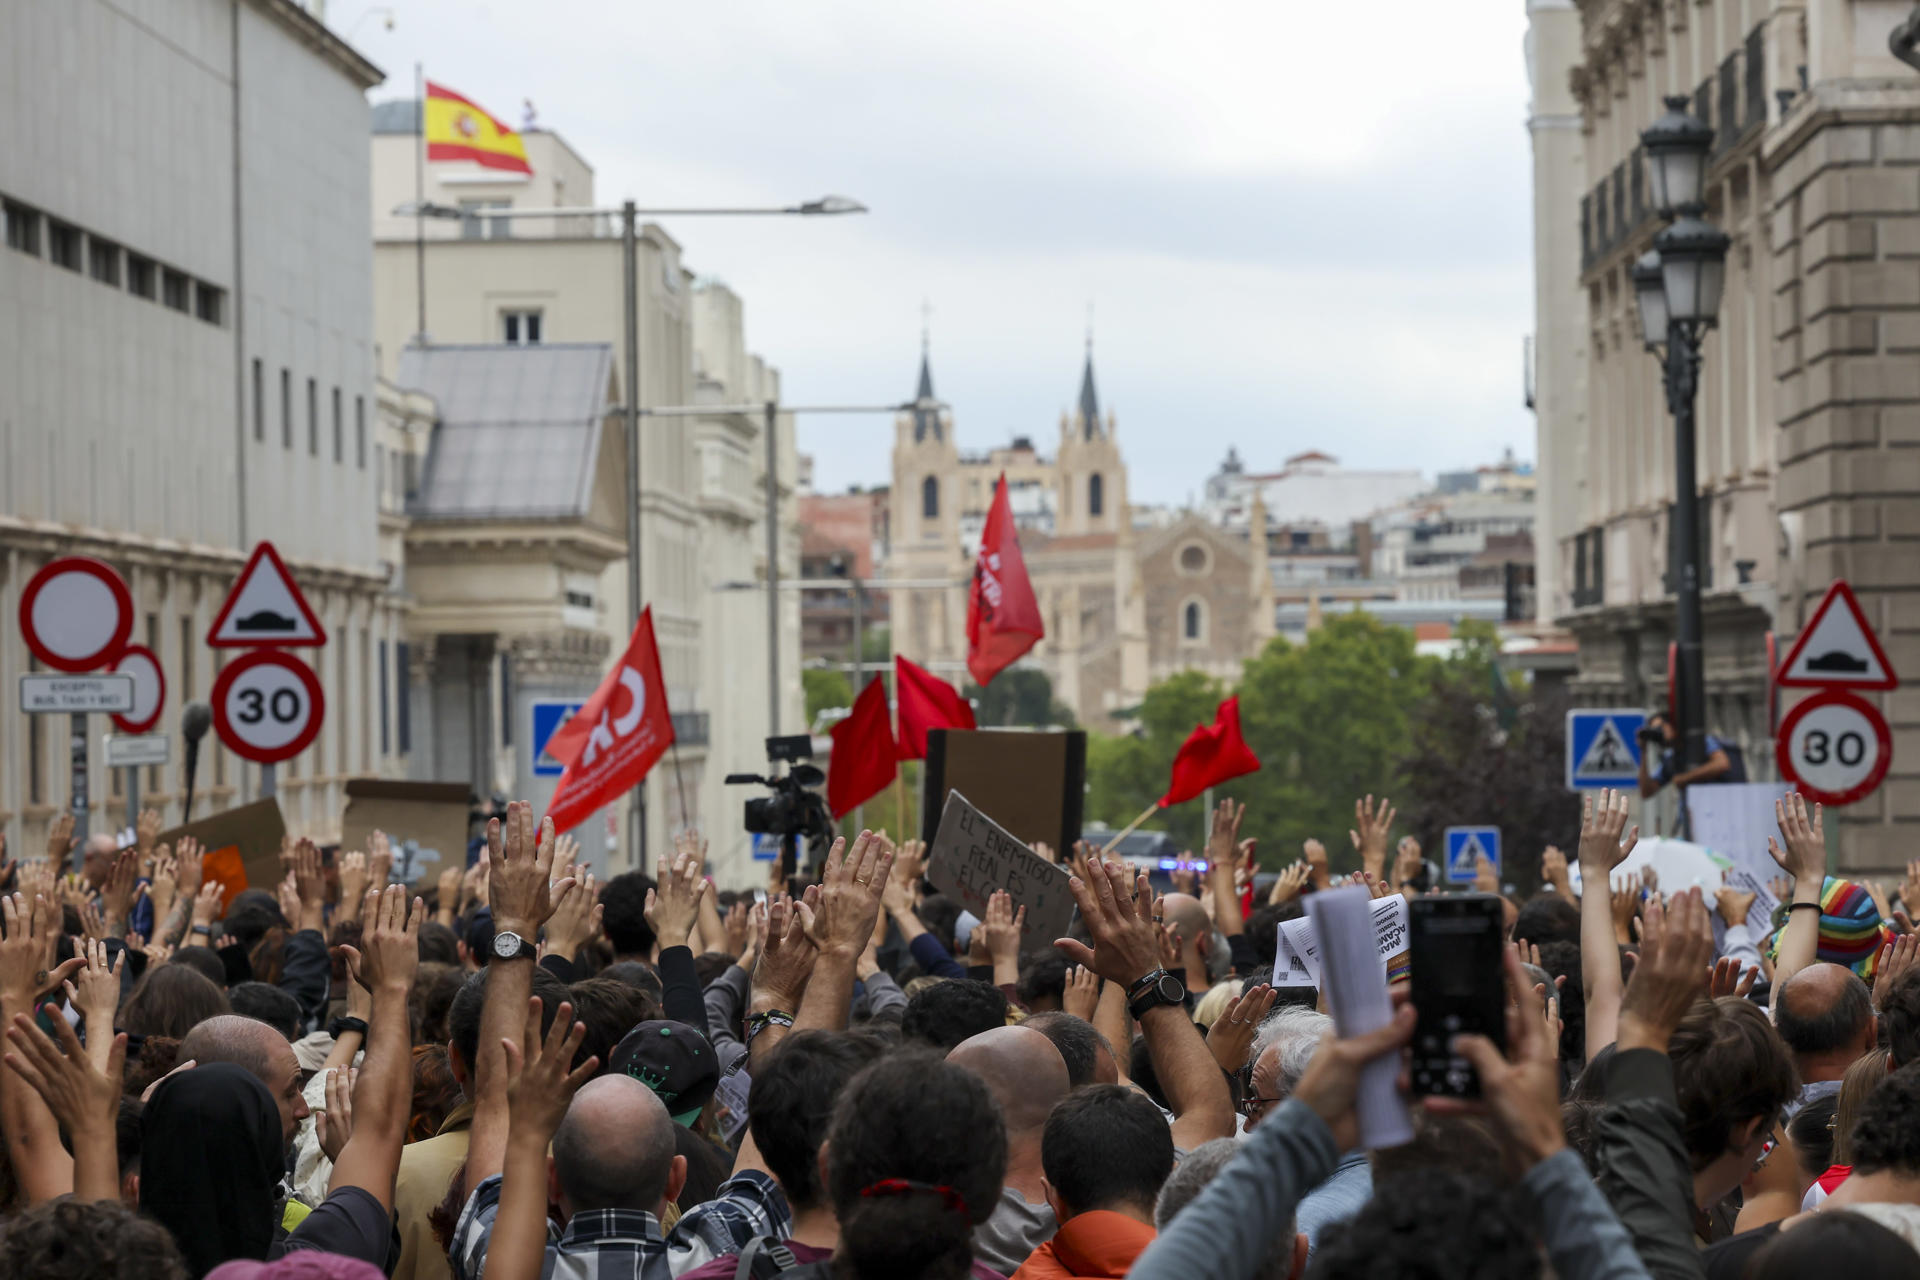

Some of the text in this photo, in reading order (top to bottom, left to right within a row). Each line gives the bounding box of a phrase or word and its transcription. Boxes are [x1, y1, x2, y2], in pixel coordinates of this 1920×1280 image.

[238, 688, 301, 724] 30
[1804, 730, 1865, 767] 30
[960, 809, 1054, 886] EL ENEMIGO
[959, 864, 976, 892] EL
[1006, 870, 1024, 896] ES
[1378, 923, 1406, 946] ACAM
